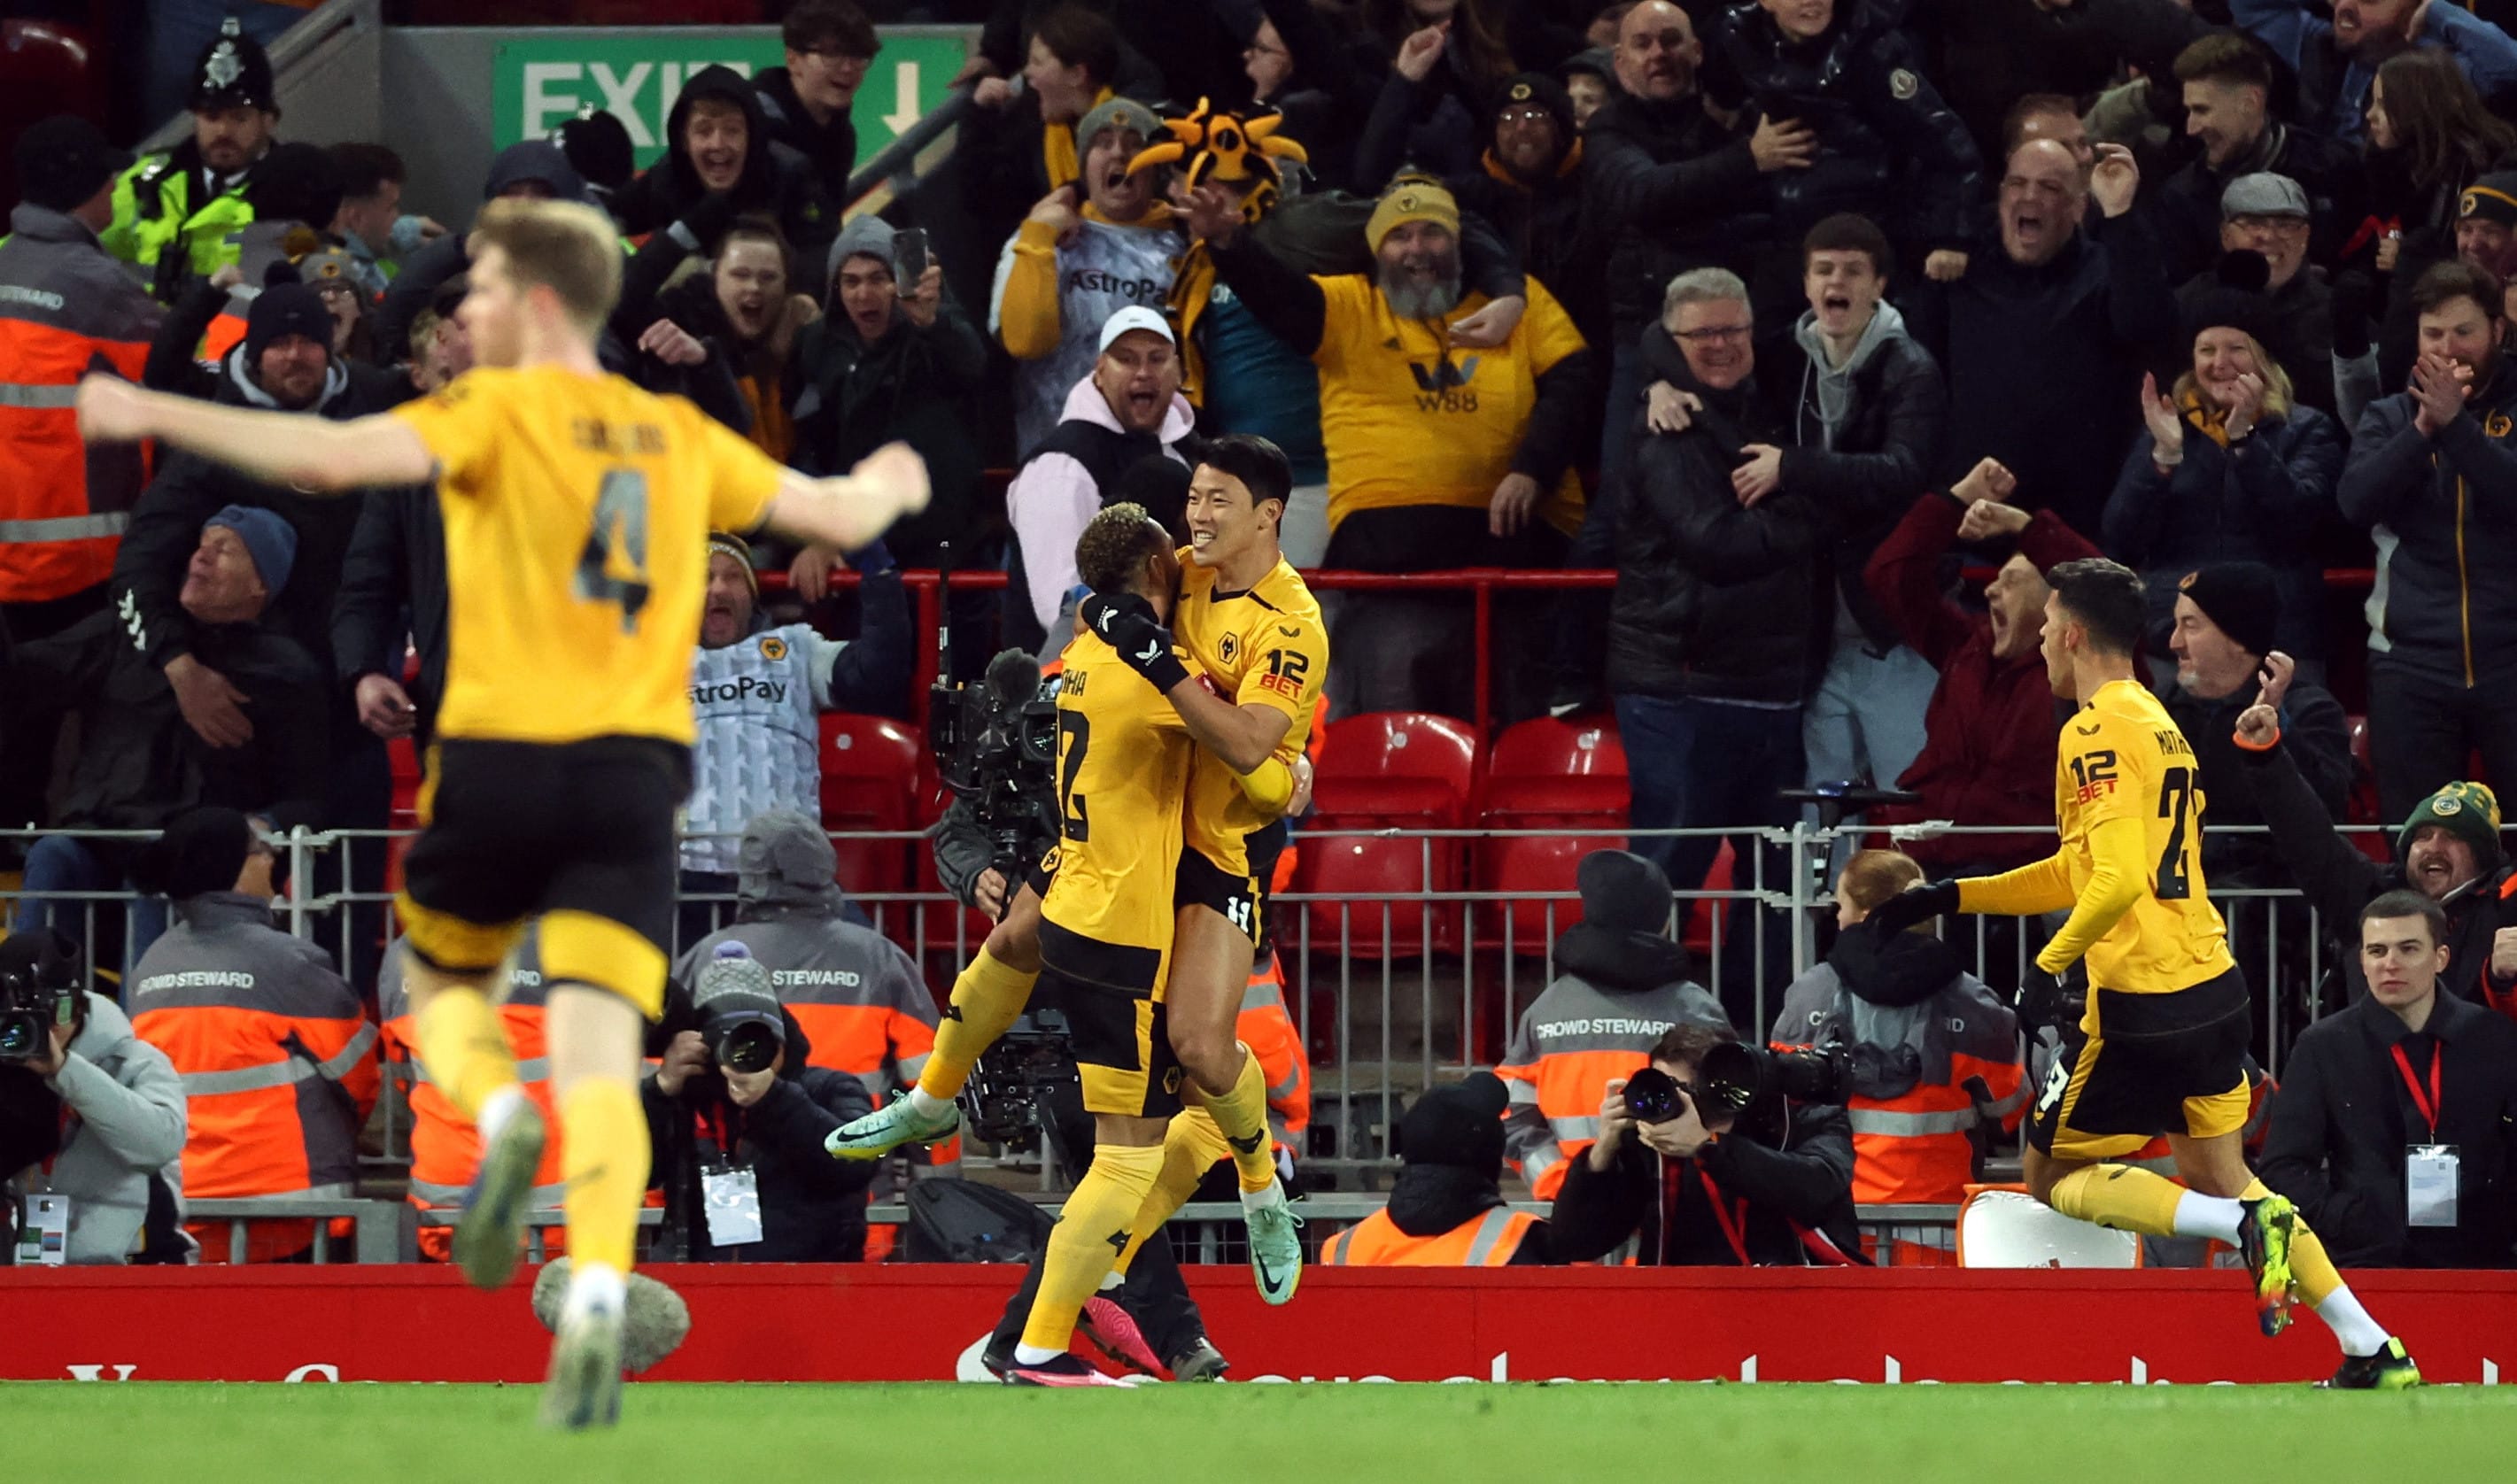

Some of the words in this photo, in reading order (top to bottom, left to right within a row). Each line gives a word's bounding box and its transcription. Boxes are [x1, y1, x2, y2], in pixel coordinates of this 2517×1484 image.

[1069, 268, 1171, 307] AstroPa
[1413, 391, 1478, 414] W88
[570, 467, 654, 638] 4
[1266, 648, 1309, 686] 12
[685, 675, 786, 704] stroPay
[1259, 673, 1304, 699] BET
[1058, 707, 1090, 843] 2
[2070, 749, 2118, 787] 12
[2077, 779, 2118, 806] BET
[176, 970, 255, 990] STEWARD
[771, 970, 860, 987] STEWARD
[1537, 1019, 1590, 1040] CROWD
